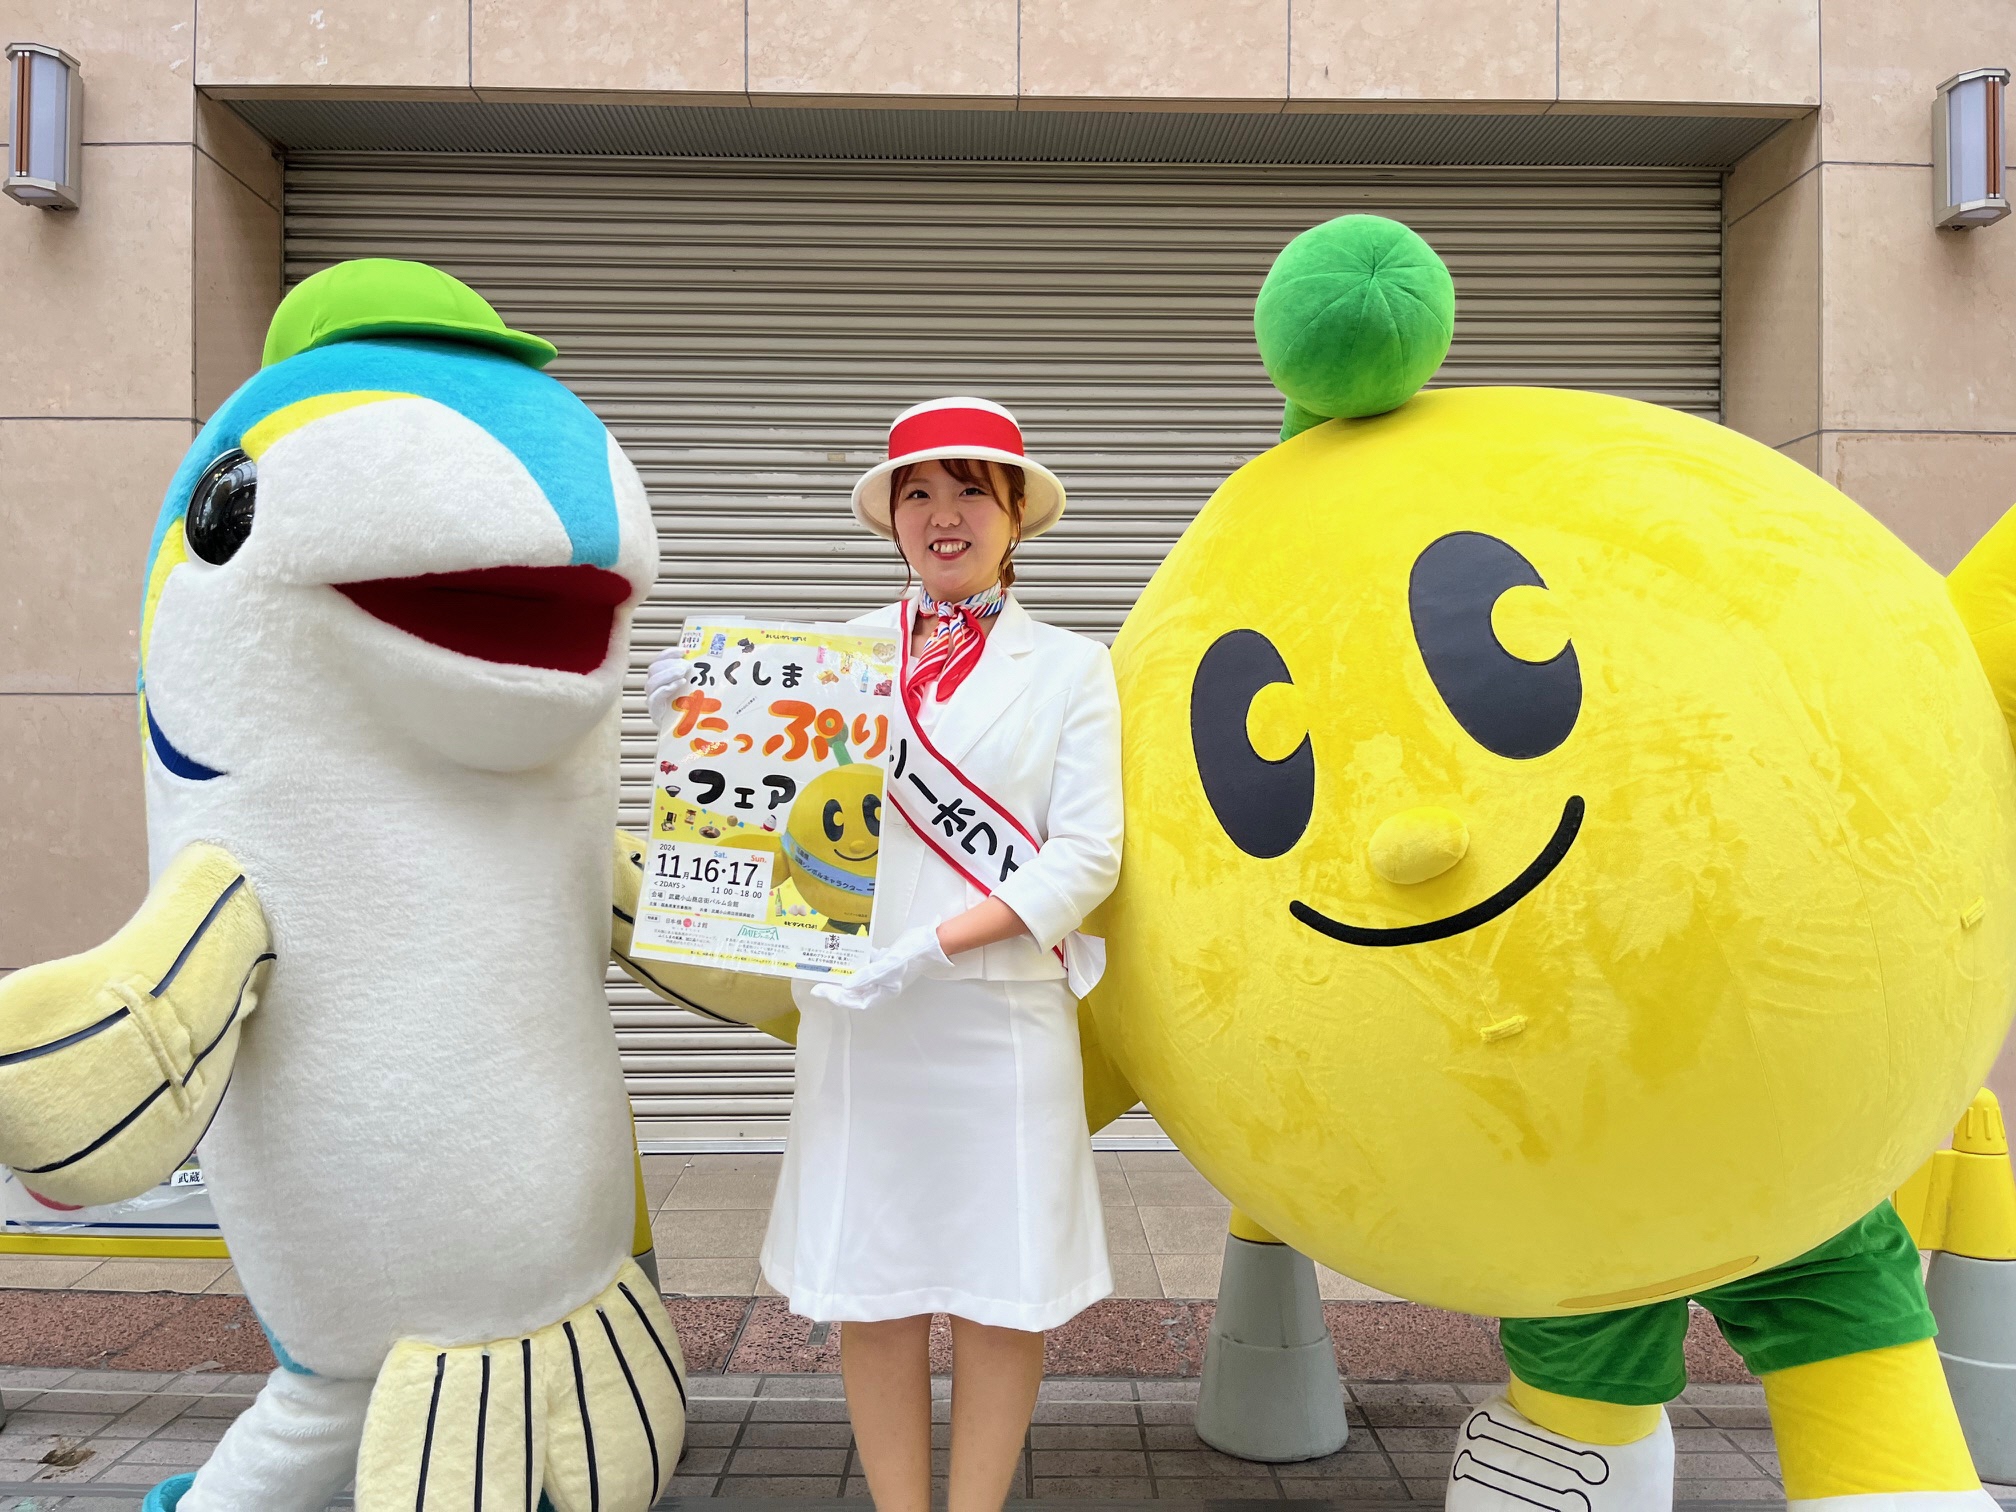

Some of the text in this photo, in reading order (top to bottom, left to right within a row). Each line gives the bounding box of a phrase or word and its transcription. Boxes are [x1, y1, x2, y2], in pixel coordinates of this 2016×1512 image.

[690, 660, 803, 688] ふくしま
[672, 689, 889, 762] たっぷり
[688, 768, 797, 810] フェア
[659, 843, 676, 851] 2024
[713, 850, 767, 863] Sat. Sun.
[651, 891, 663, 899] 会場
[178, 1171, 203, 1184] 武蔵
